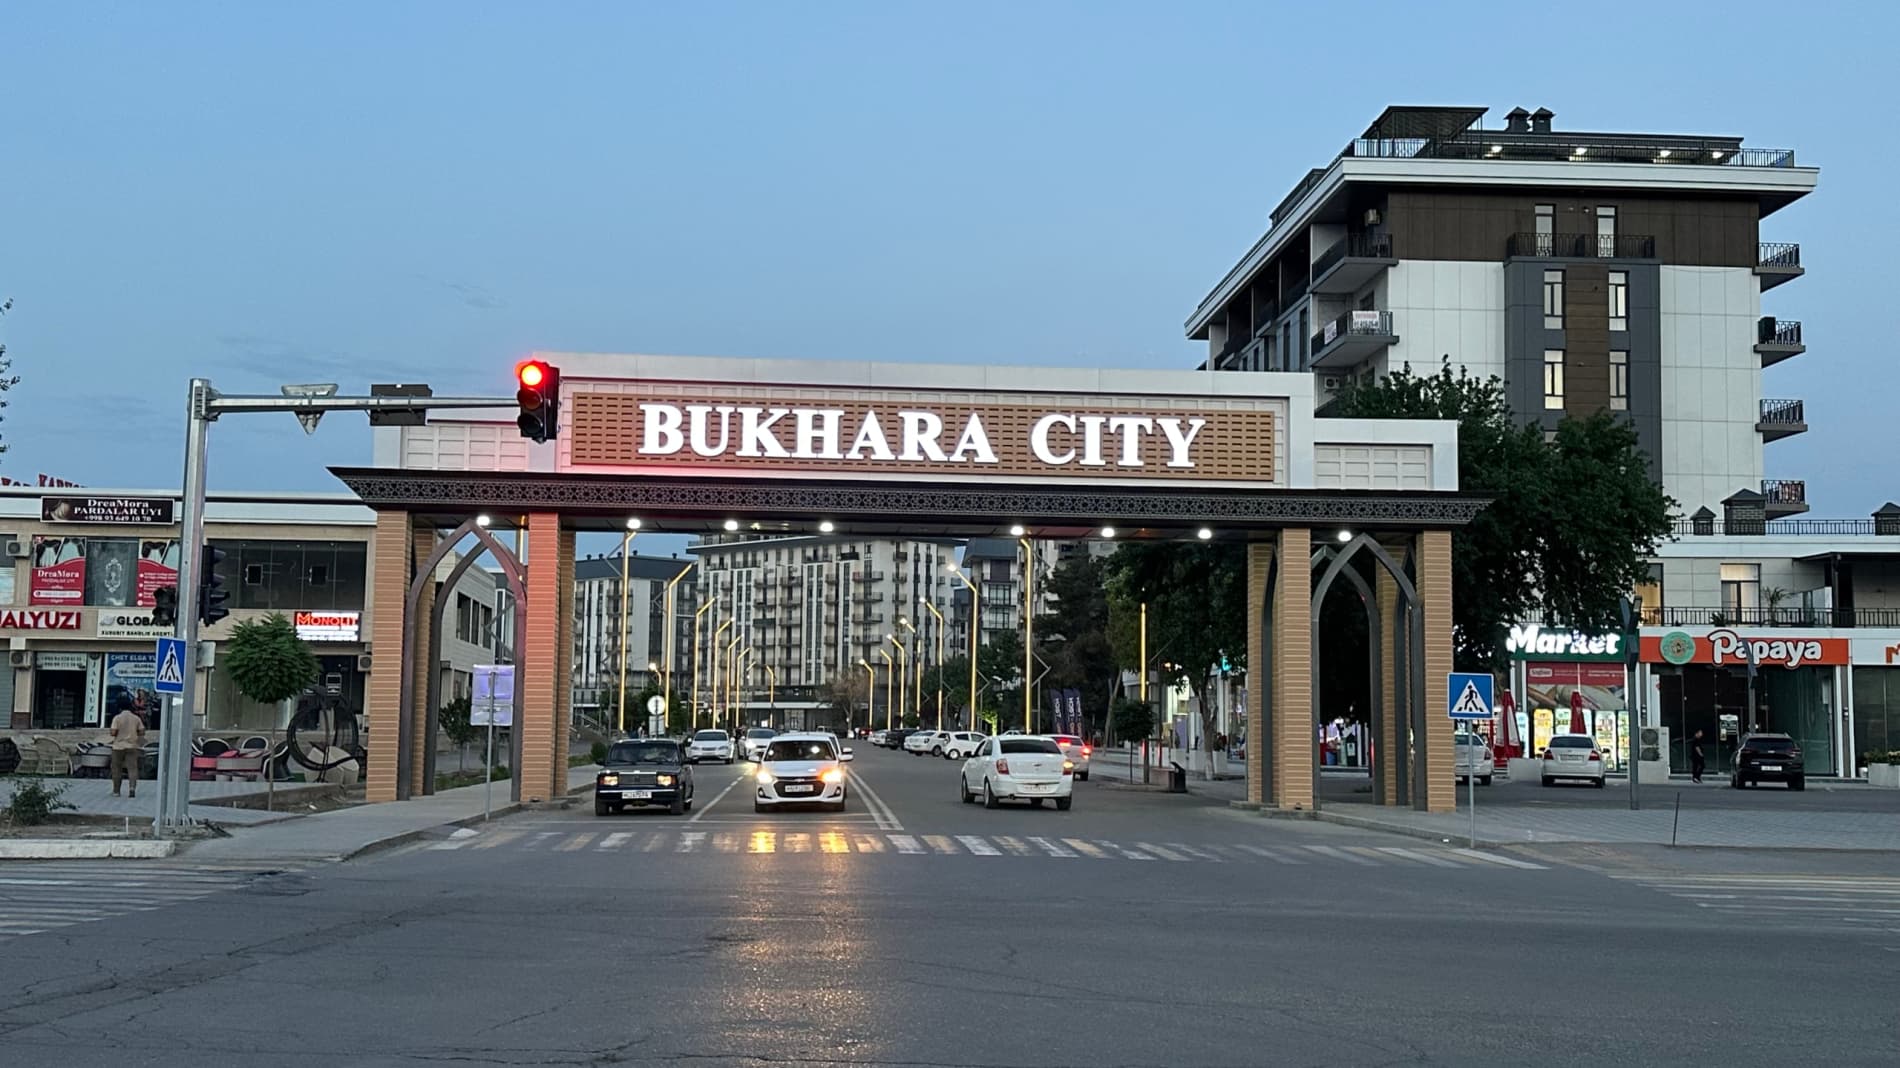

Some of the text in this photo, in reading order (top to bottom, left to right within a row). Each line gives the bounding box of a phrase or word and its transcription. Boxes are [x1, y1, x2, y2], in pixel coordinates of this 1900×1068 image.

[638, 403, 1206, 468] BUKHARA CITY
[74, 507, 138, 515] PARDALAR
[87, 499, 149, 508] DreaMora
[0, 611, 81, 630] ALYUZI
[1505, 624, 1621, 655] Market
[1708, 630, 1823, 668] Papaya
